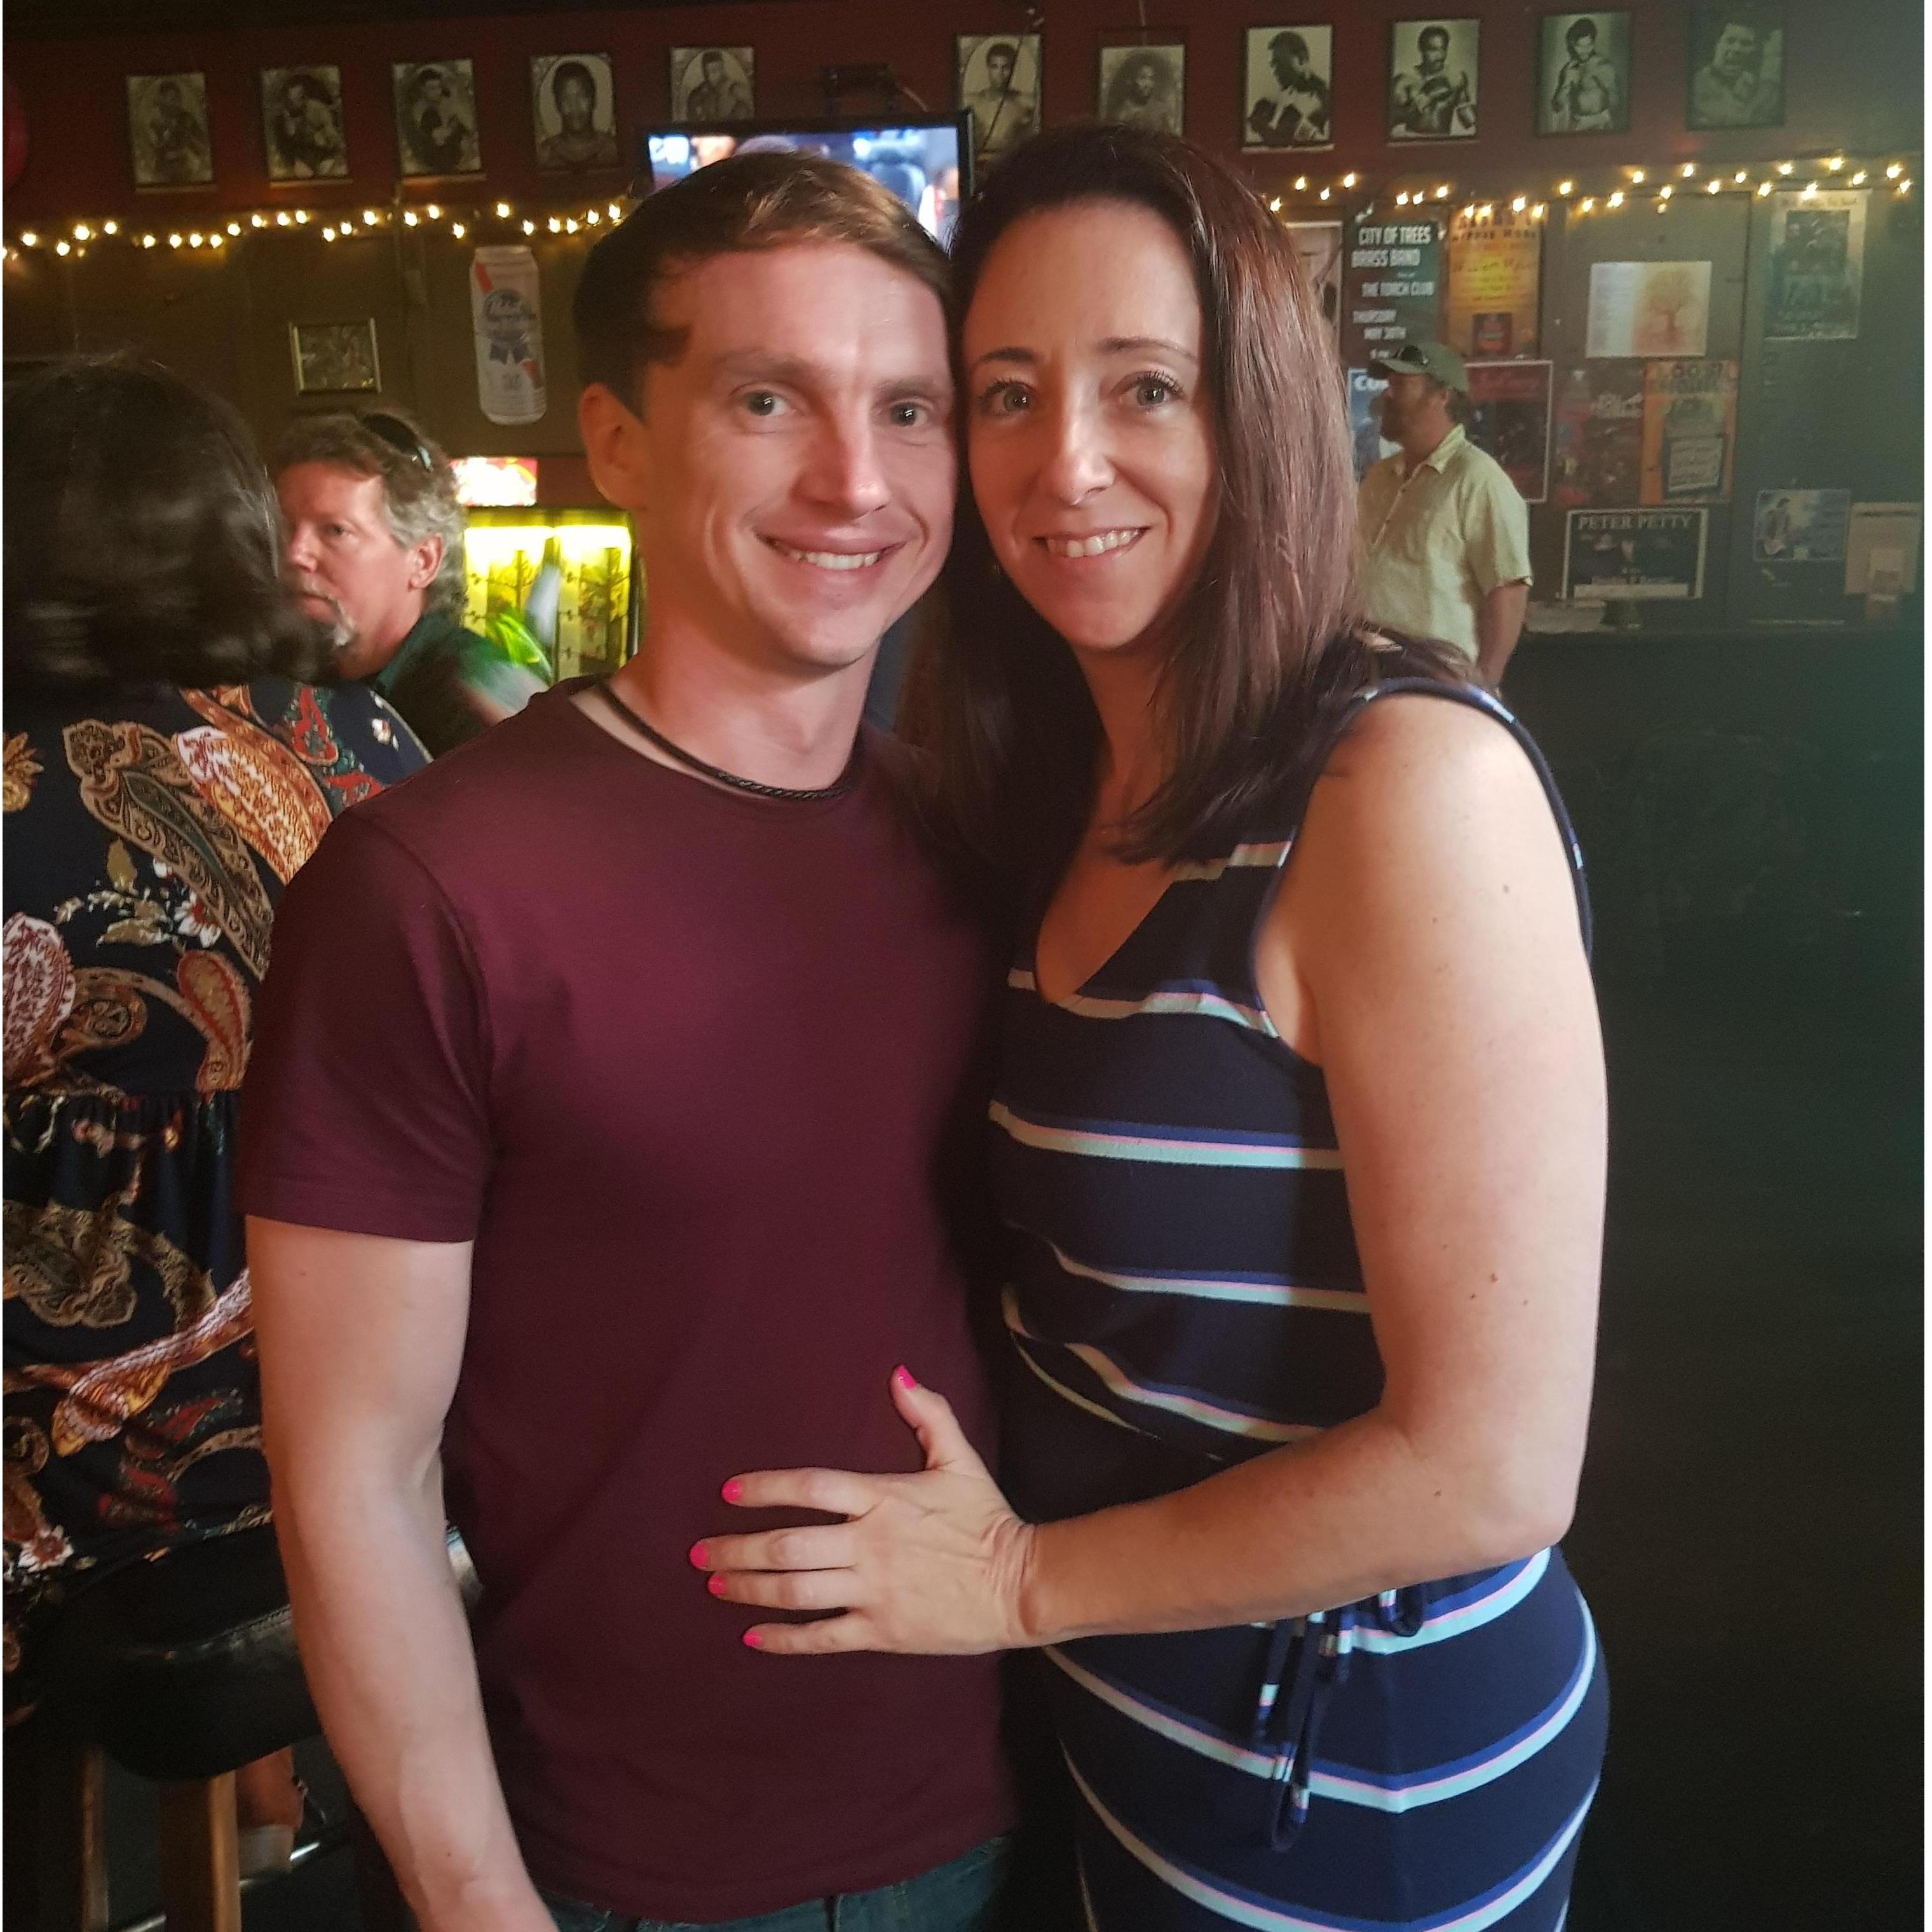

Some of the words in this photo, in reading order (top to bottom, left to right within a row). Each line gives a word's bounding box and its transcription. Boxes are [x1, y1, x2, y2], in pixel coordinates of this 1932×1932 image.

[1359, 227, 1382, 245] CITY
[1383, 226, 1399, 245] OF
[1399, 225, 1431, 245] TREES
[1579, 515, 1631, 530] PETER
[1638, 514, 1693, 529] PETTY
